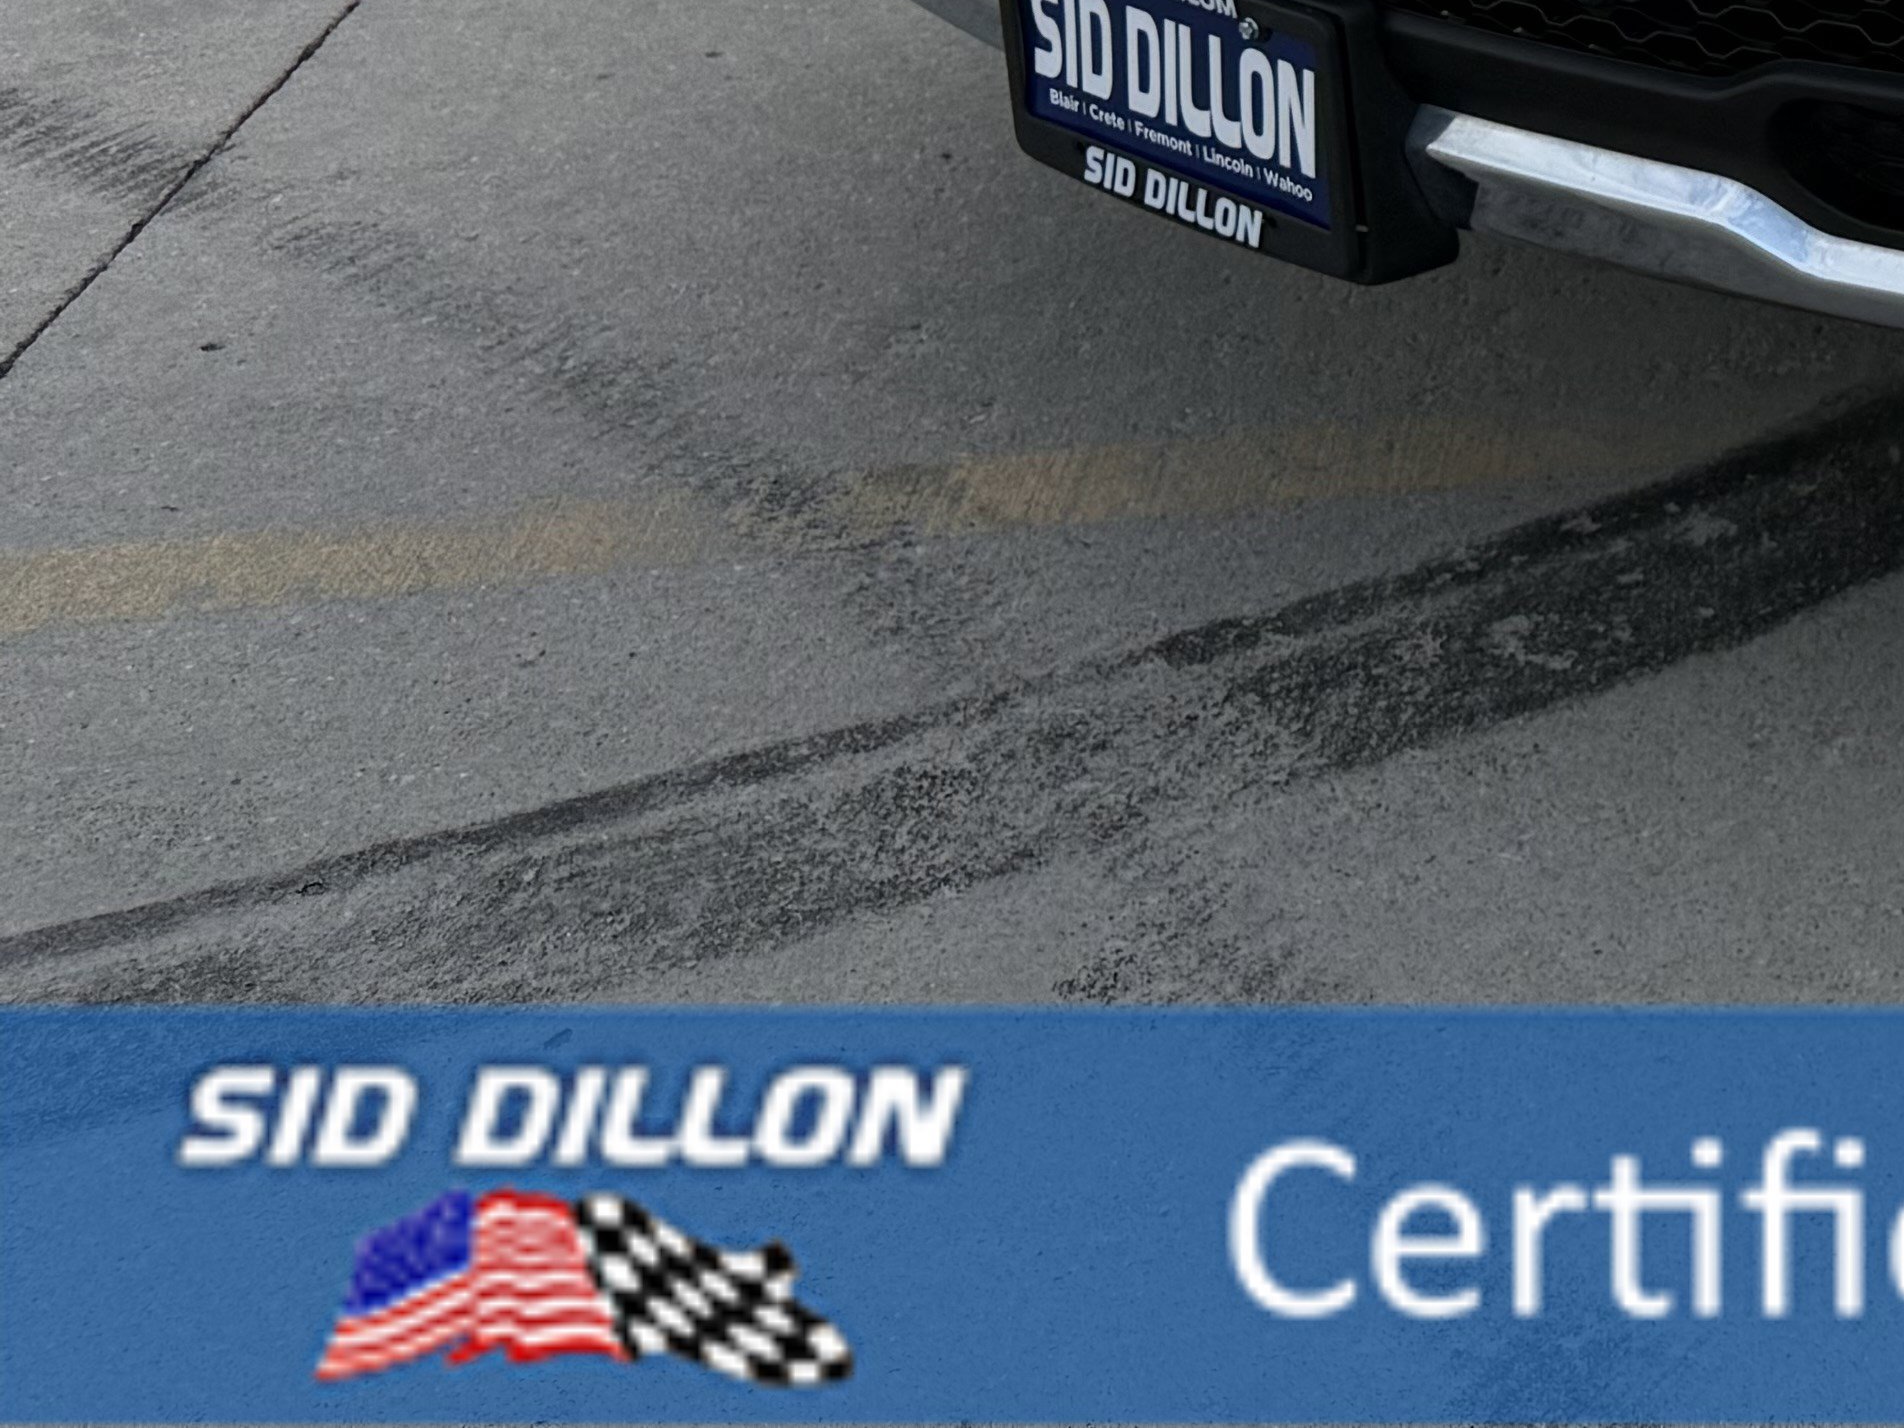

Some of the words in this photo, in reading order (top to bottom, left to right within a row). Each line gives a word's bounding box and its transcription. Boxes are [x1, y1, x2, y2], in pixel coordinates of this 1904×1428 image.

[1049, 87, 1080, 114] Blair
[1088, 103, 1125, 132] Crete
[1134, 120, 1193, 157] Fremont
[1202, 144, 1254, 180] Lincoln
[1262, 167, 1314, 203] Wahoo
[1125, 4, 1317, 180] DILLON
[1083, 144, 1137, 198] SID
[1143, 167, 1265, 250] DILLON
